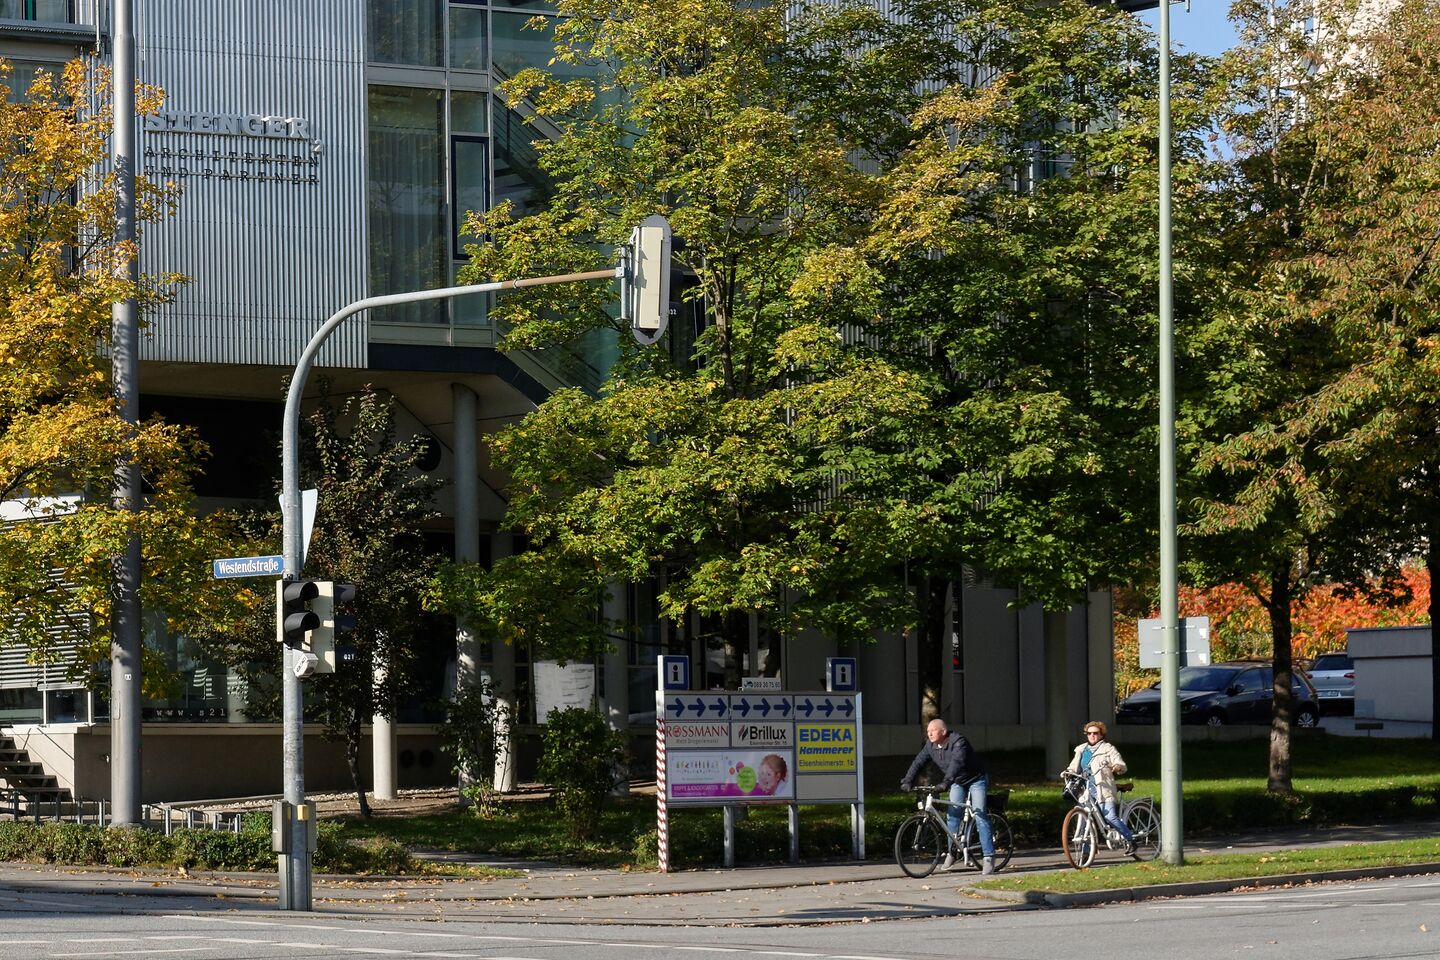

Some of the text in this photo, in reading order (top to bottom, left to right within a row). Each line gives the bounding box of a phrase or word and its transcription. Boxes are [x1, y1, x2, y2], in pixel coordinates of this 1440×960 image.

[144, 110, 310, 139] STENGER
[144, 146, 320, 167] ARCHITEKTEN
[144, 165, 320, 185] UND PARTNER
[218, 558, 279, 575] Westendstraße
[665, 725, 729, 738] ROSSMANN
[749, 725, 787, 740] Brillux
[799, 728, 852, 742] EDEKA
[799, 746, 854, 755] Hammerer
